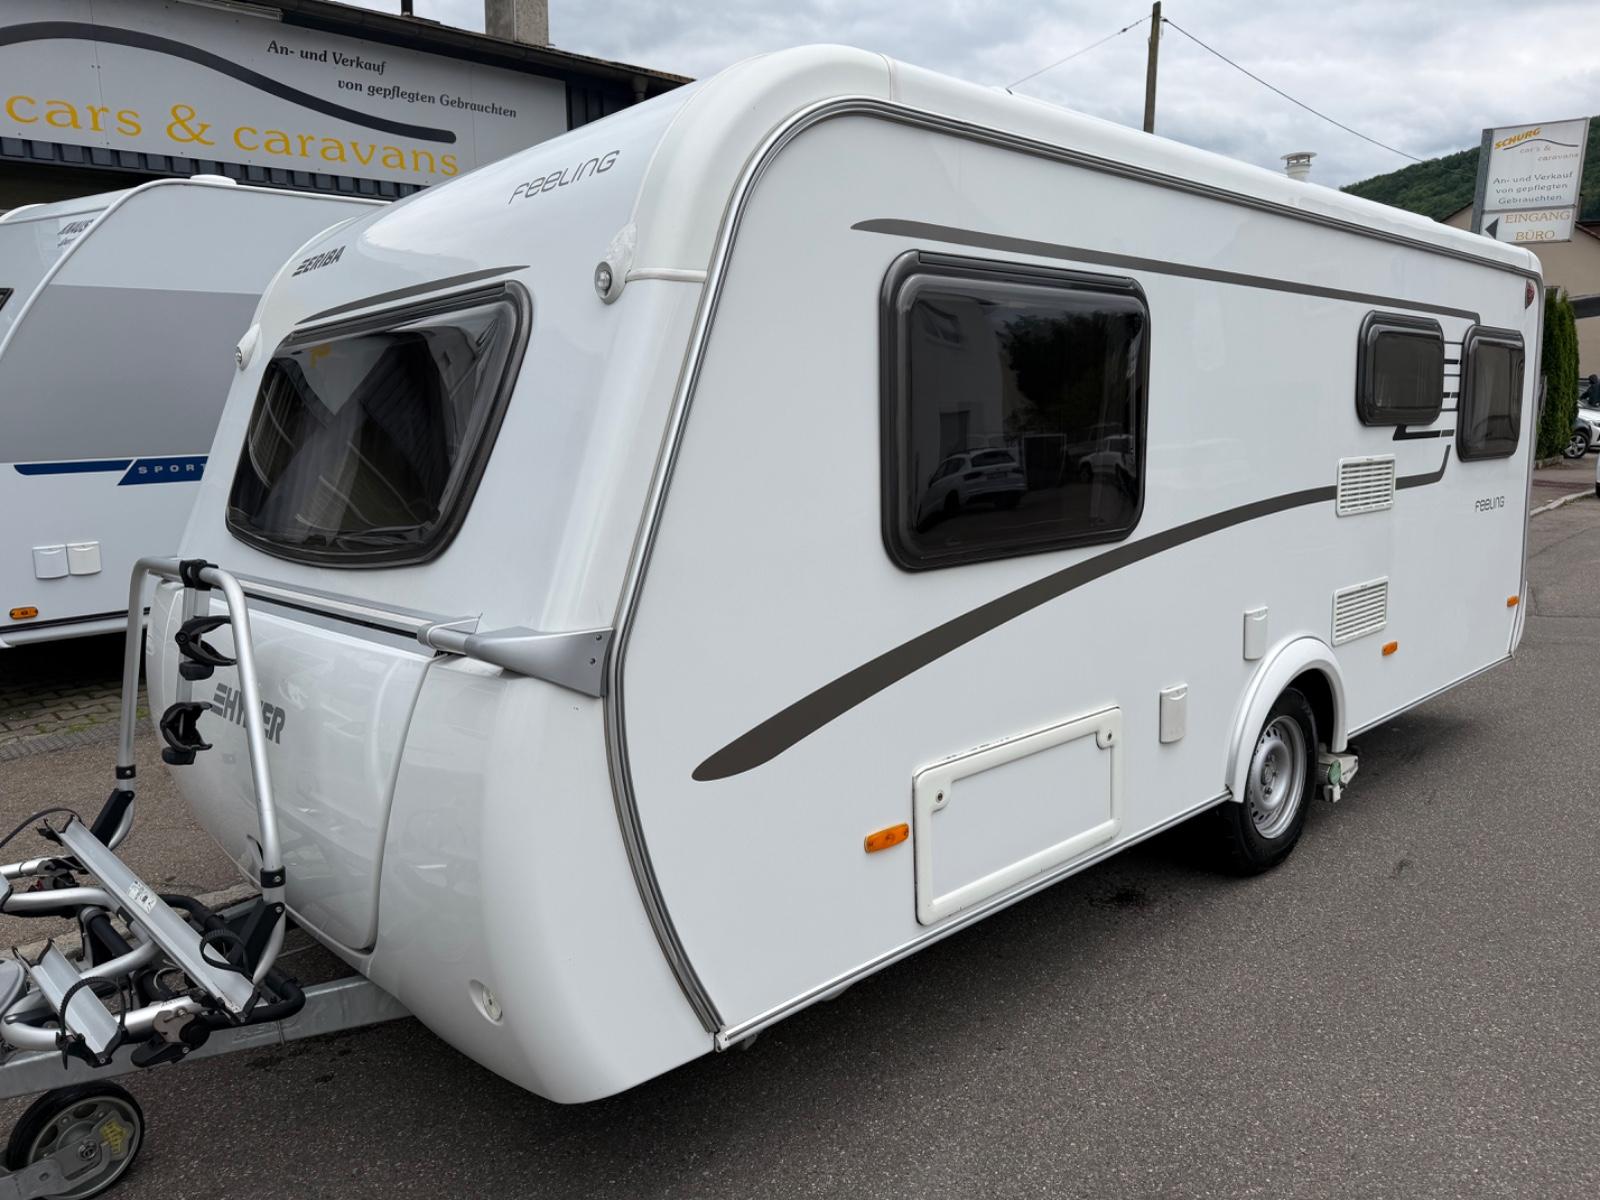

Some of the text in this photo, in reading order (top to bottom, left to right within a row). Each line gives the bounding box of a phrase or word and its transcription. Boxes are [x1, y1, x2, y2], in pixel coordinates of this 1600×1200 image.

[266, 40, 386, 75] An- und Verkauf
[338, 79, 517, 118] von gepflegten Gebrauchten
[5, 95, 459, 176] cars & caravans
[1495, 128, 1541, 149] SCHURG
[1513, 174, 1531, 183] und
[1534, 171, 1573, 181] Verkauf
[1516, 183, 1568, 193] gepflegten
[1498, 194, 1562, 205] Gebrauchten
[1505, 211, 1570, 224] EINGANG
[1516, 229, 1555, 240] BÜRO
